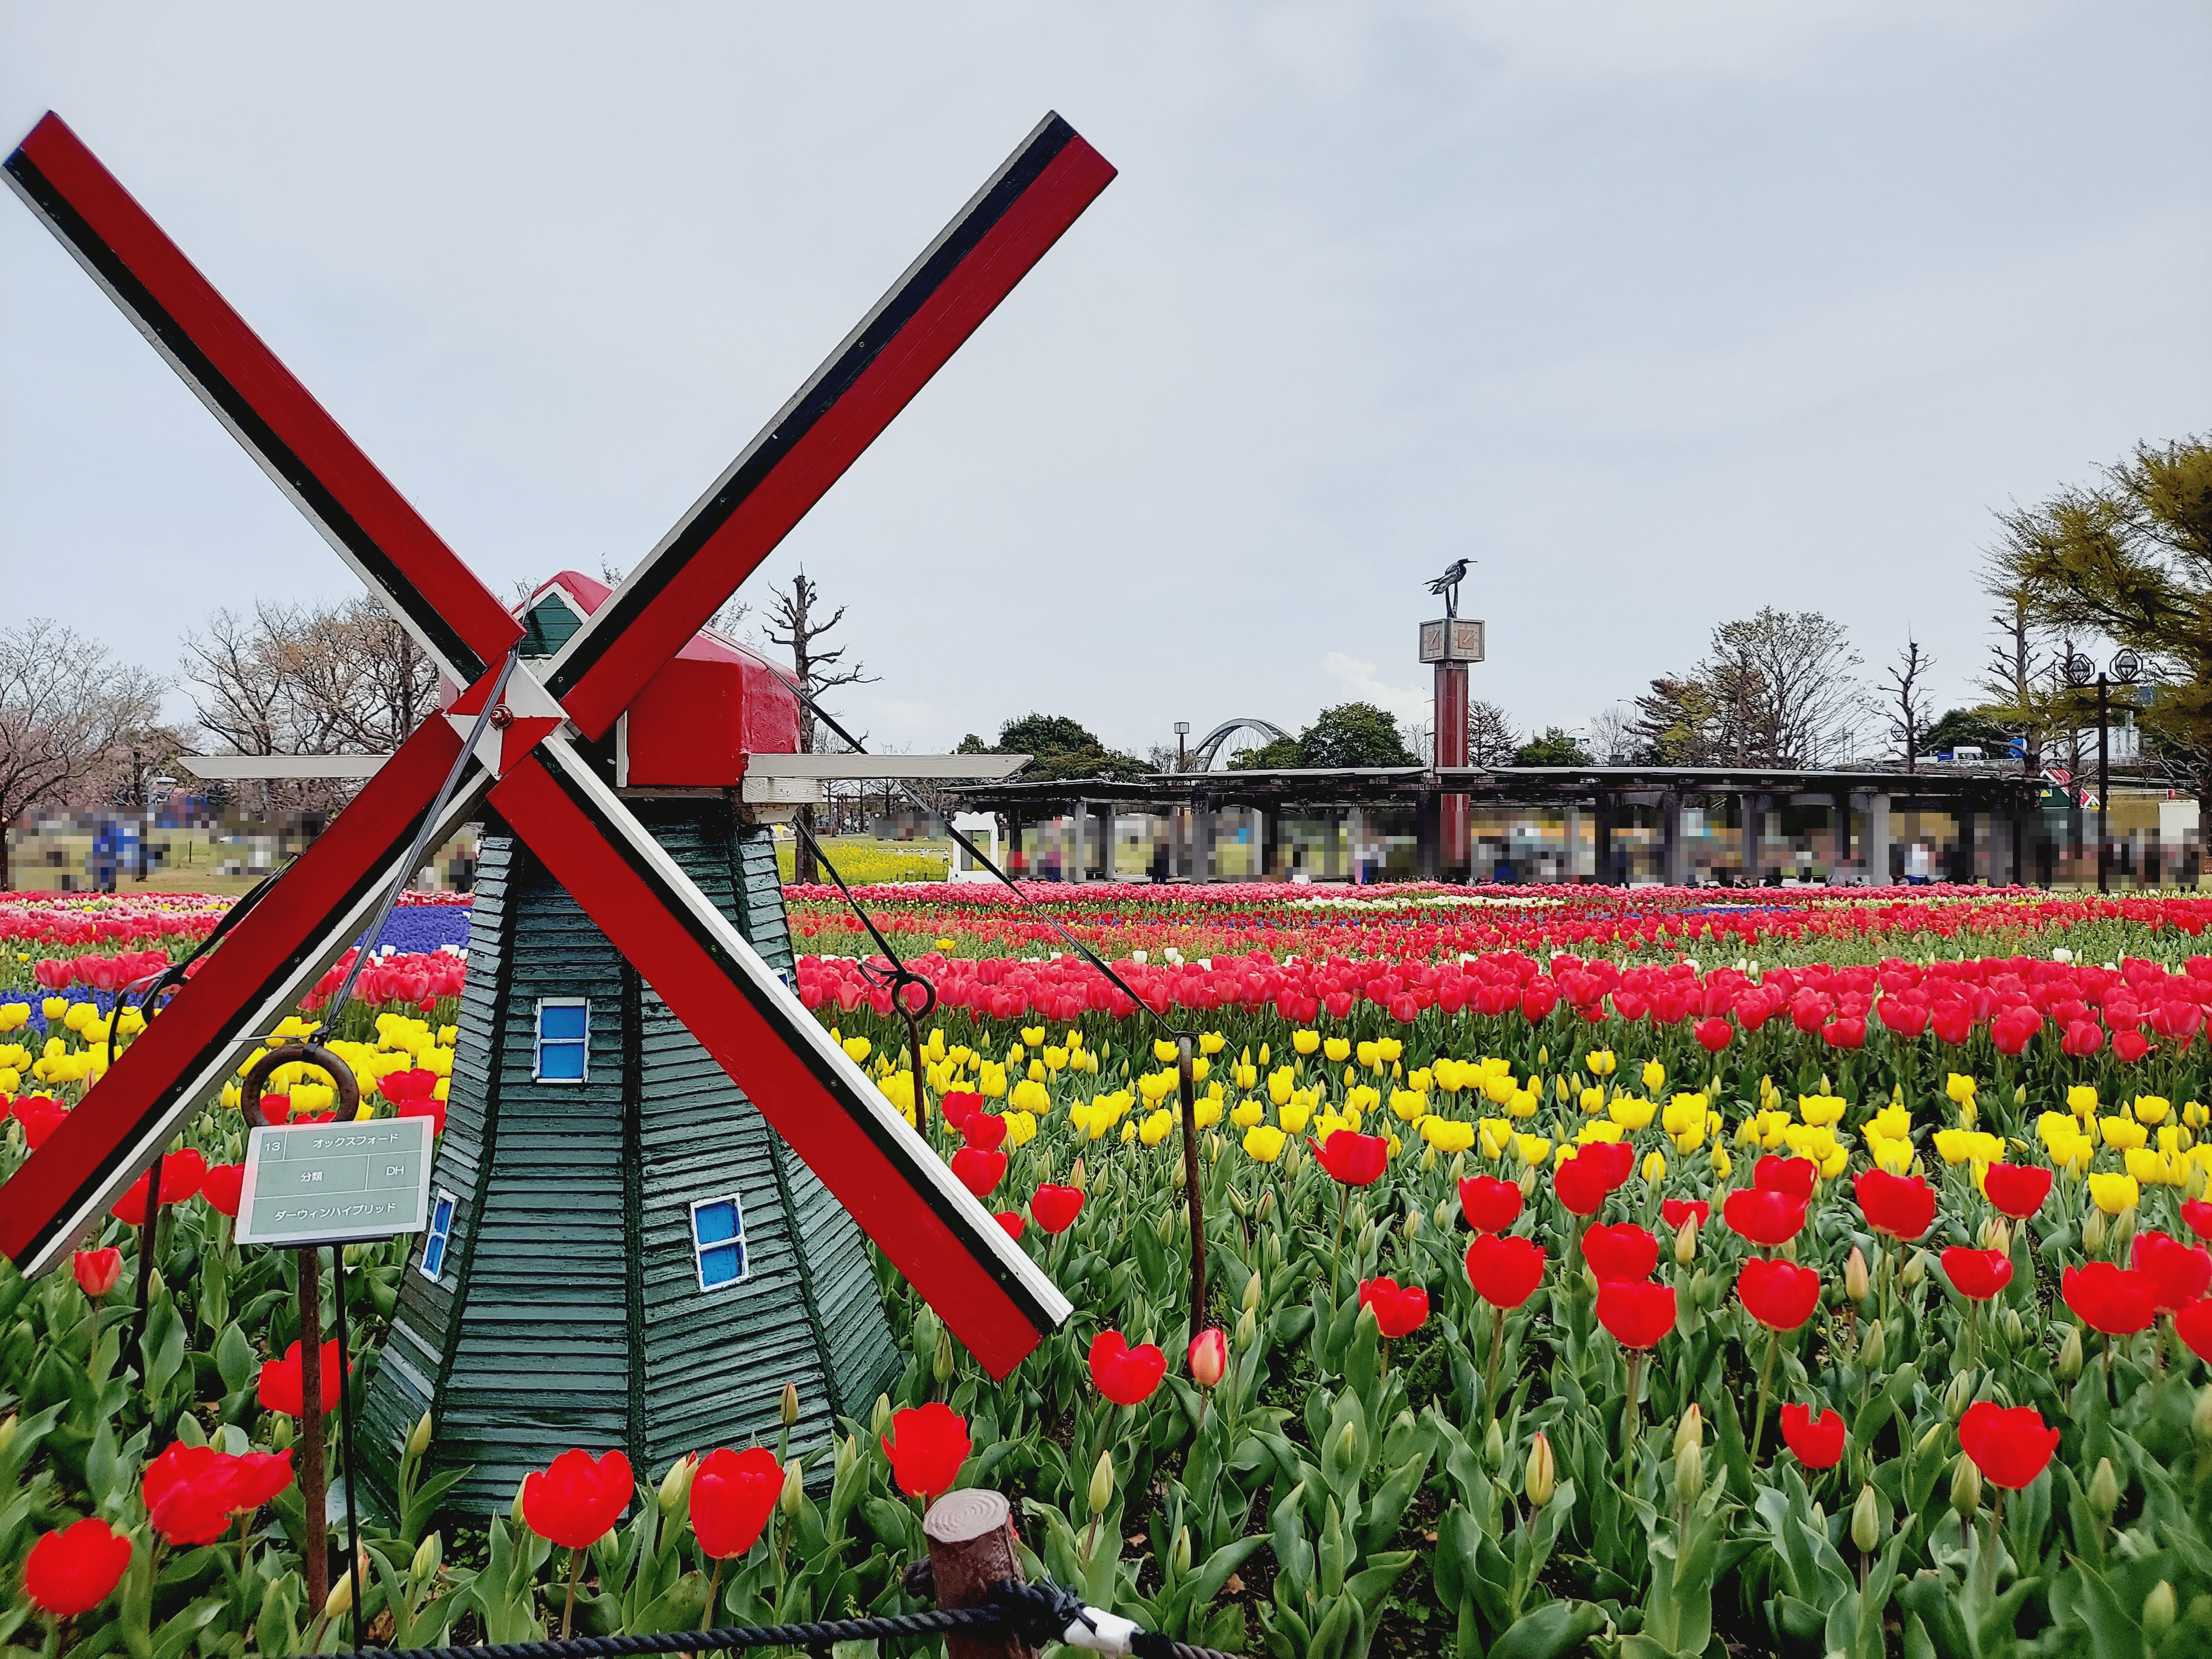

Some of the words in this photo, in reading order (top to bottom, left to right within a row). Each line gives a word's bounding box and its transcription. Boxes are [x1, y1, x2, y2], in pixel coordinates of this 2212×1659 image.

[265, 1141, 281, 1151] 13
[313, 1133, 398, 1149] オックスフォード
[386, 1165, 404, 1176] DH
[300, 1171, 322, 1182] 分類
[274, 1202, 396, 1221] ダーウィンハイブリッド
